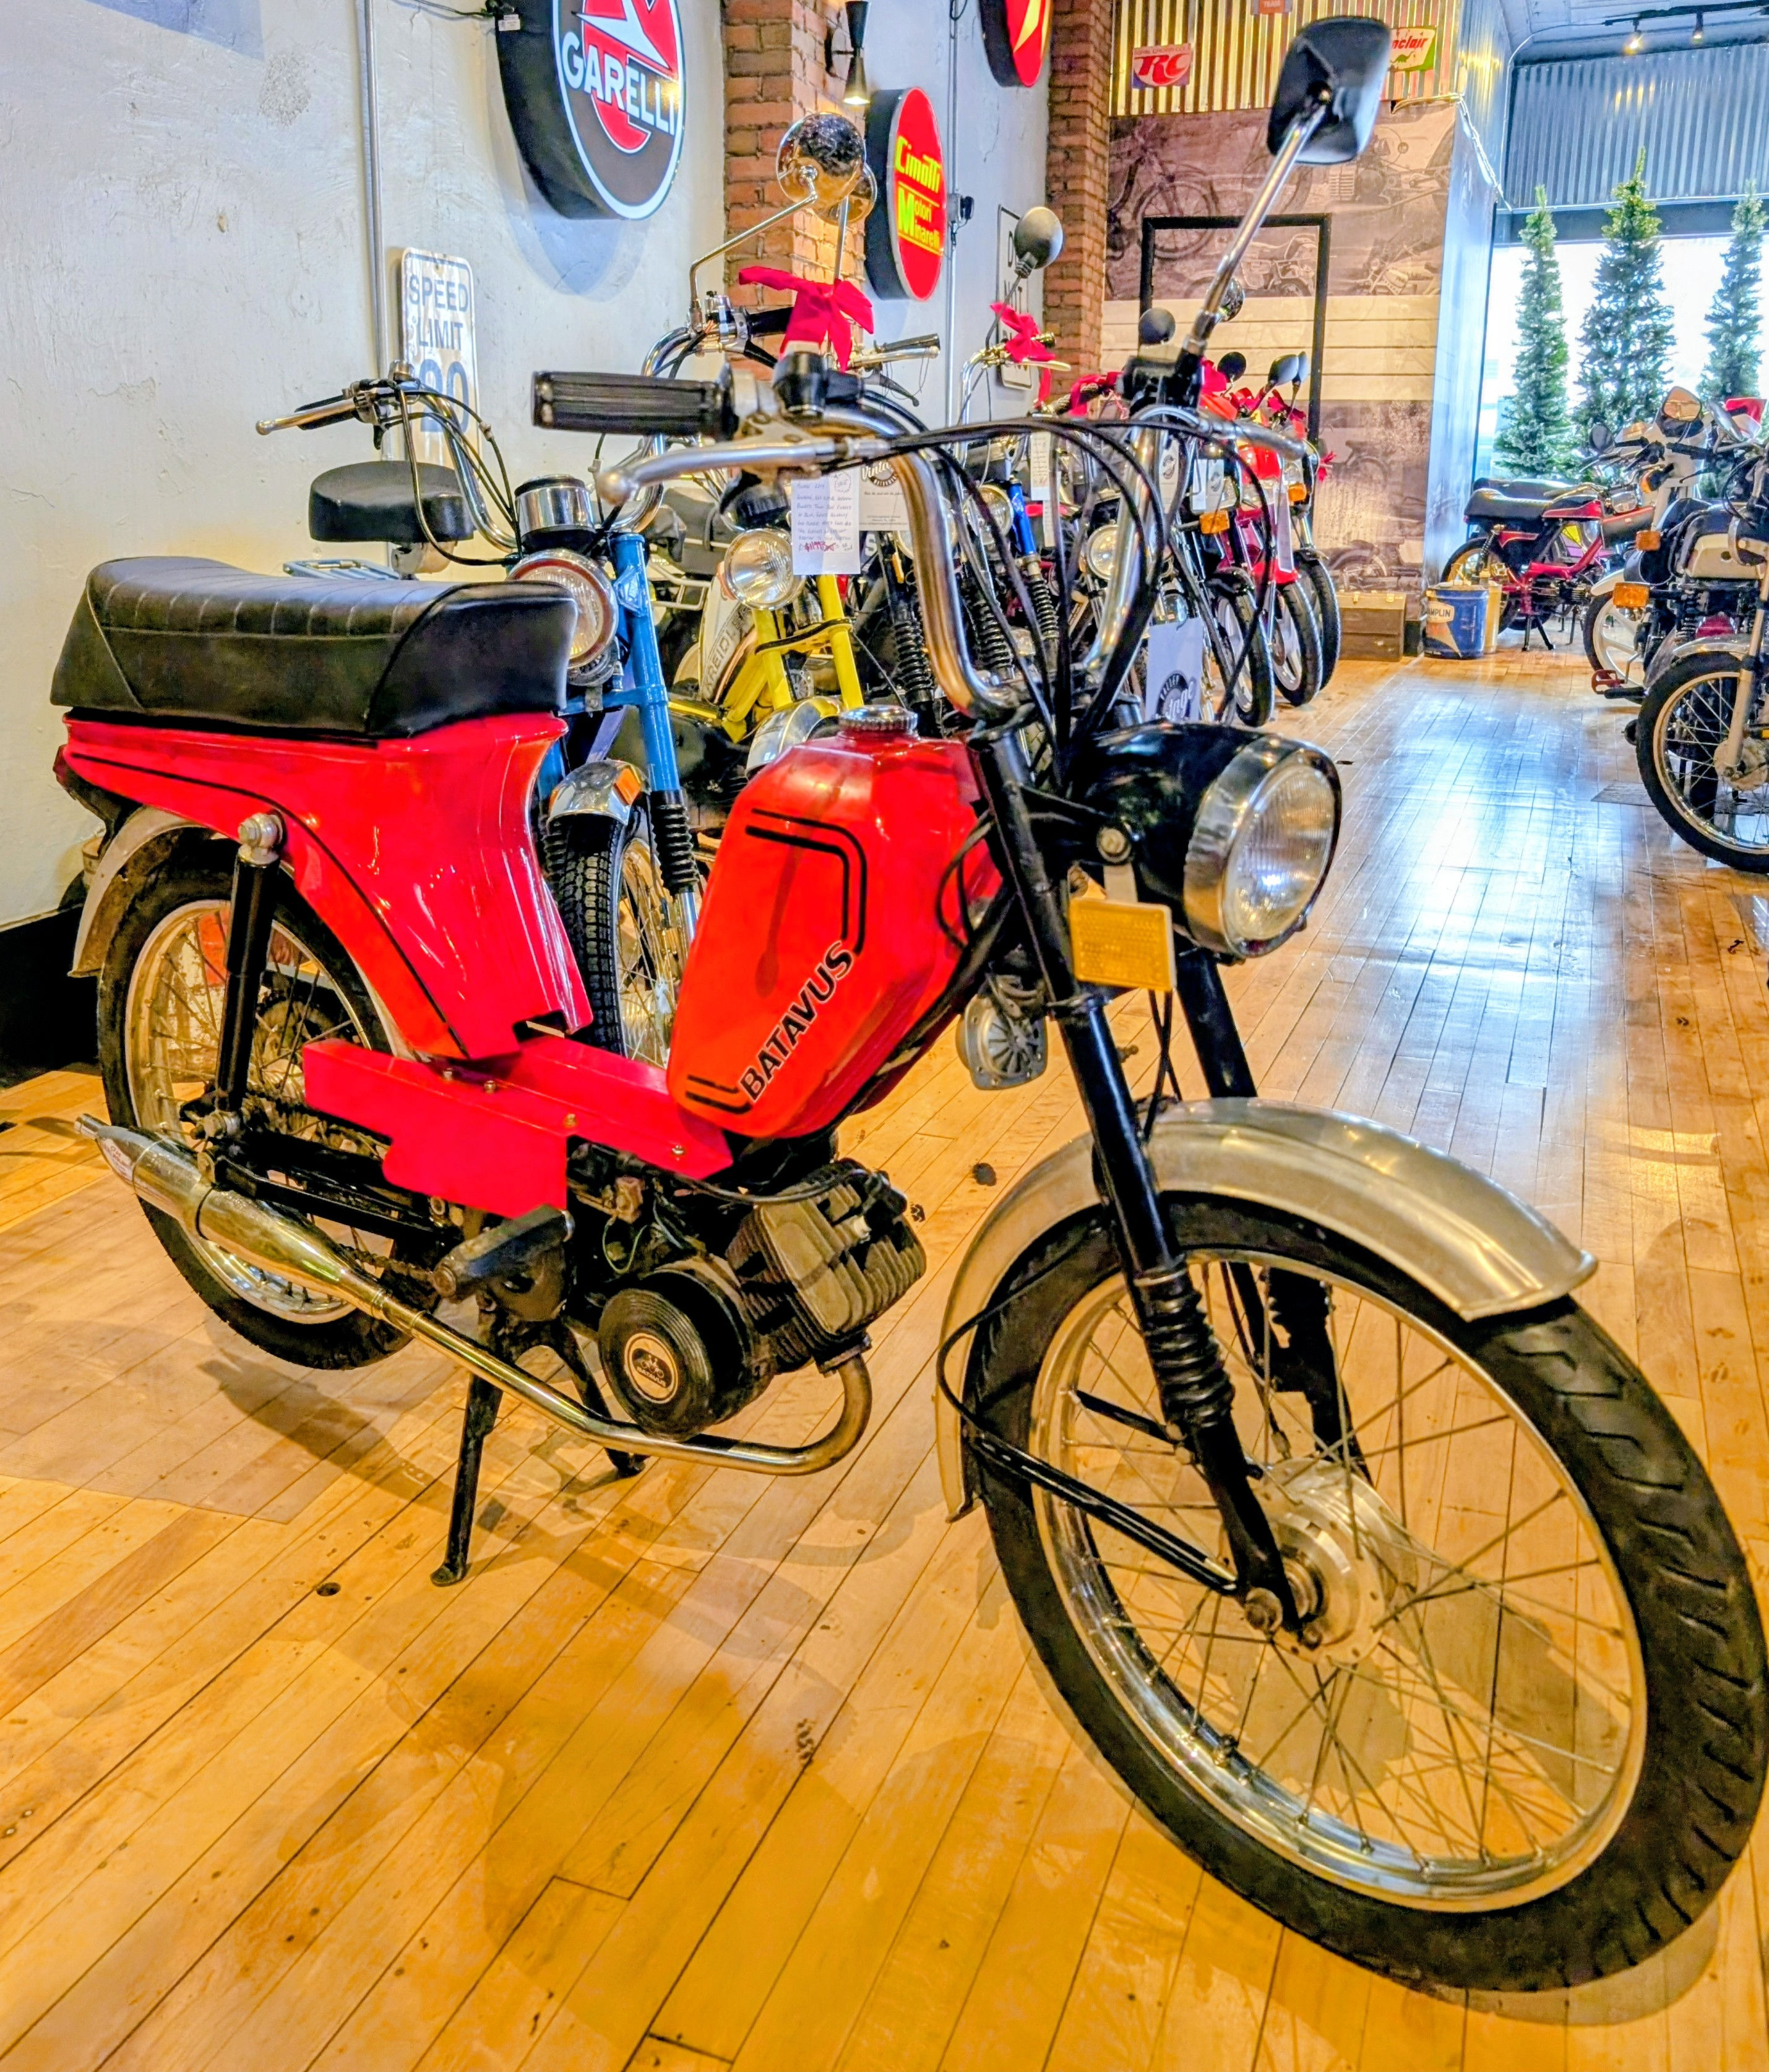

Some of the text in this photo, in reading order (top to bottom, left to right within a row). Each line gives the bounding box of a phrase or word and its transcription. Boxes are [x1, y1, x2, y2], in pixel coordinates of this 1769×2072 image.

[1392, 36, 1429, 49] nclair
[562, 31, 675, 135] GARELLI
[1134, 53, 1189, 84] RC
[408, 273, 469, 312] SPEED
[418, 317, 463, 351] LIMIT
[419, 359, 469, 432] 20
[861, 461, 894, 480] Vinta
[1164, 681, 1194, 721] tage
[737, 940, 854, 1103] BATAVUS
